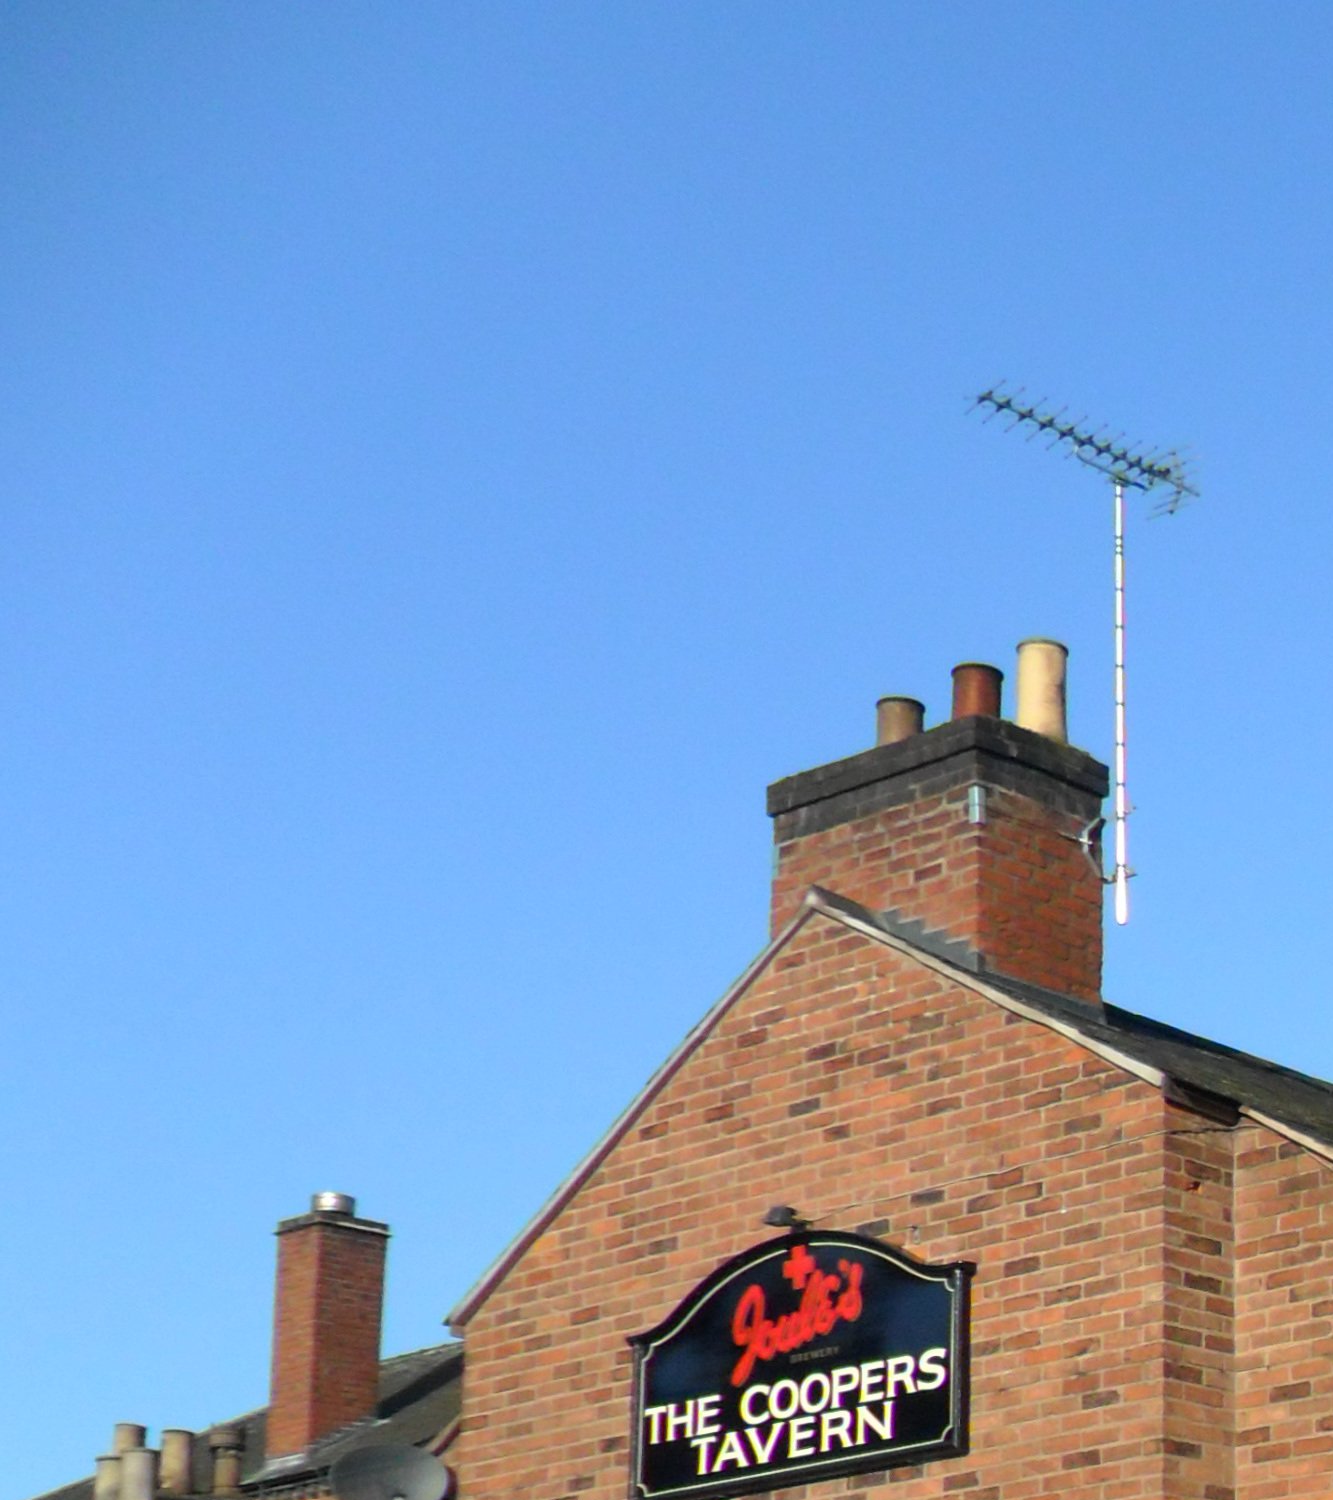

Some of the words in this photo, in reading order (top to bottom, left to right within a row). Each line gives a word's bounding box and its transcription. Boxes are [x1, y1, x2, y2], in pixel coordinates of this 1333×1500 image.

[645, 1394, 722, 1445] THE
[740, 1347, 948, 1425] COOPERS
[691, 1400, 896, 1476] TAVERN
